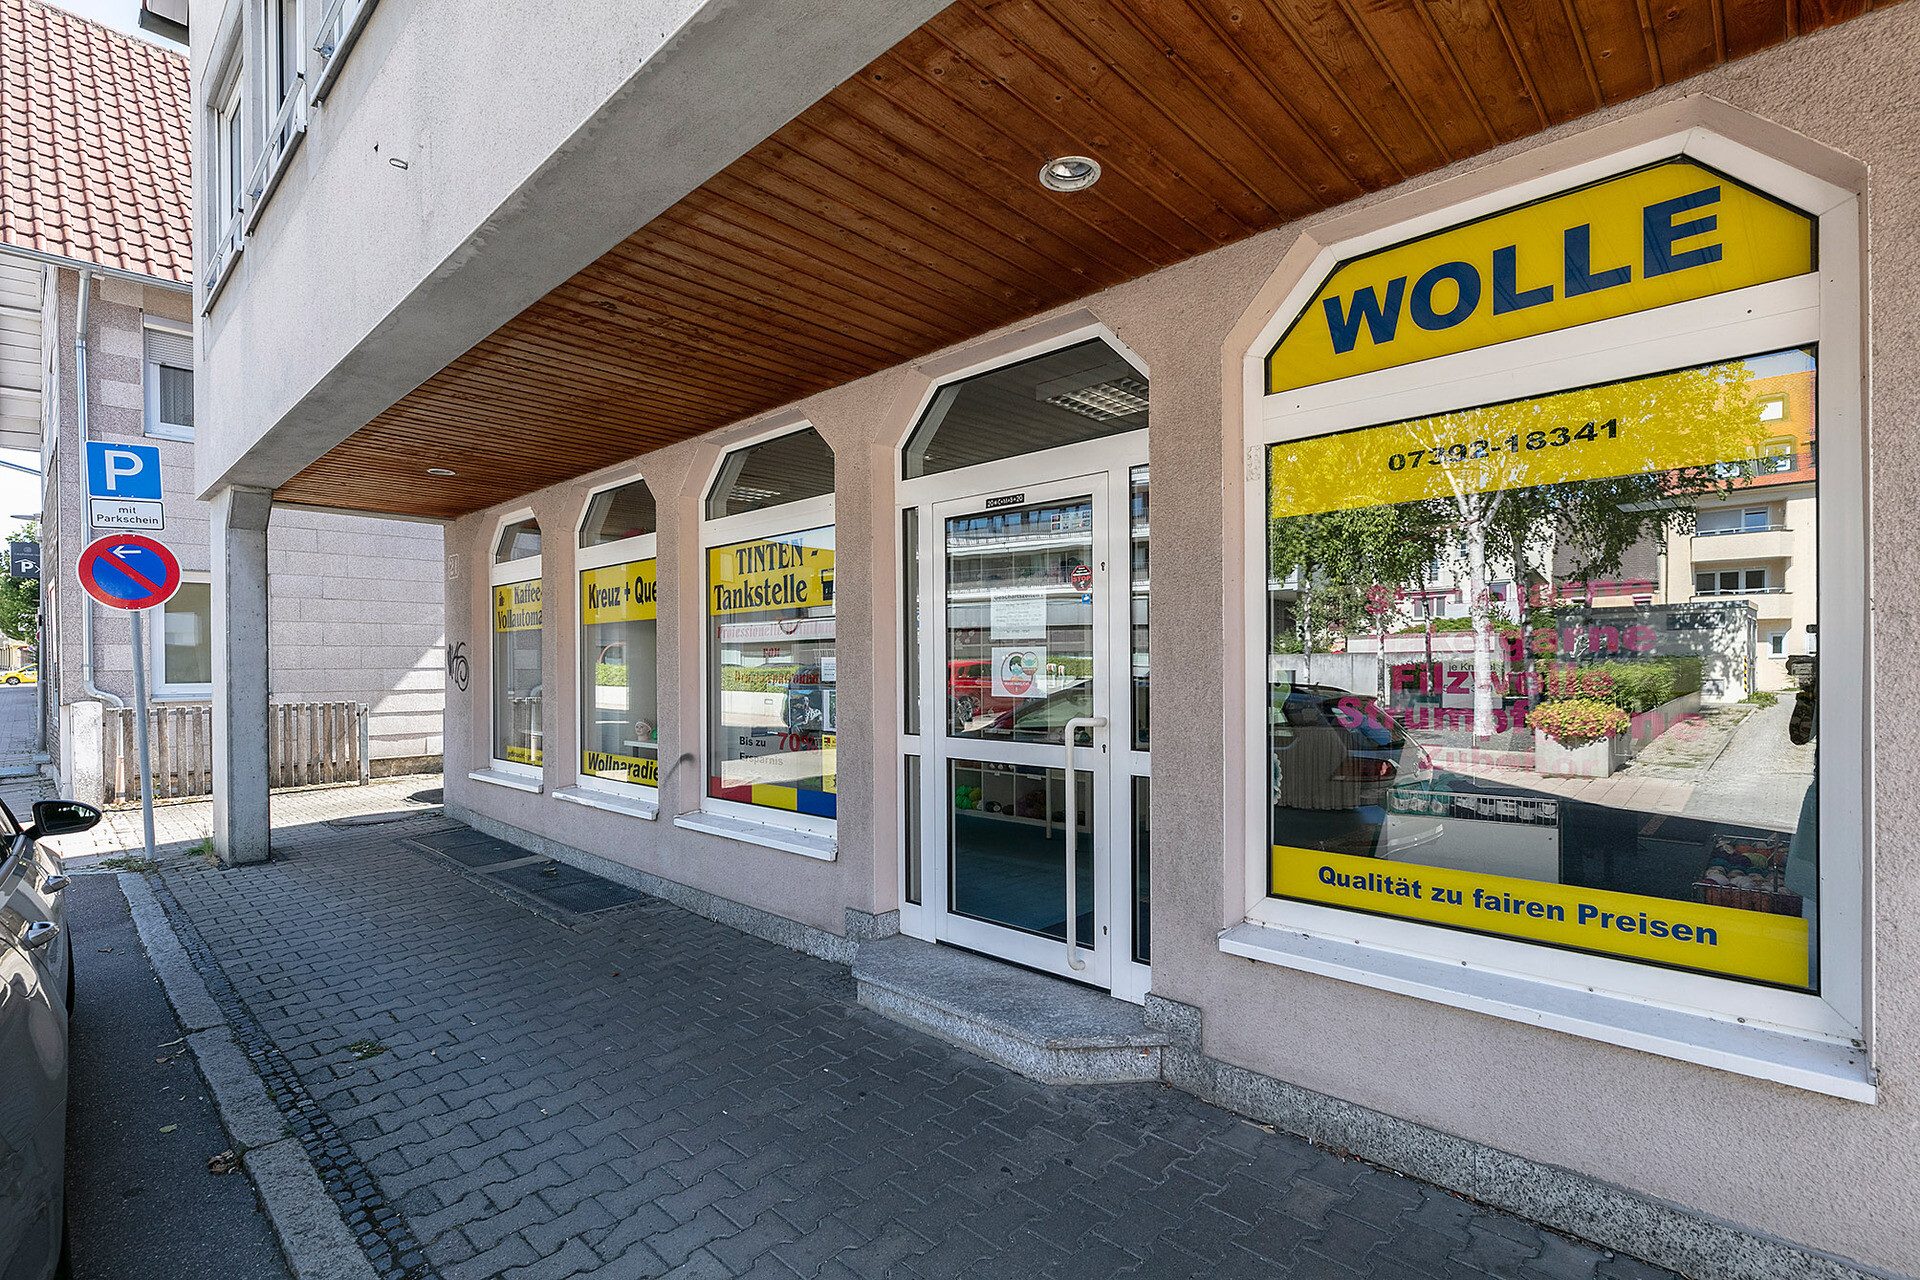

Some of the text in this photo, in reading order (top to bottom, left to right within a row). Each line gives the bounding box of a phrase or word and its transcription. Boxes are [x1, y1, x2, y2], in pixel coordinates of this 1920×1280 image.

[1322, 185, 1723, 354] WOLLE
[1388, 418, 1617, 472] 07392-18341
[104, 450, 143, 490] P
[97, 513, 159, 525] Parkschein
[118, 506, 137, 514] mit
[736, 539, 804, 576] TINTEN
[588, 576, 657, 610] Kreuz + Que
[714, 574, 808, 611] Tankstelle
[740, 736, 753, 747] Bis
[755, 739, 767, 748] zu
[776, 732, 818, 754] 70%
[740, 752, 784, 766] Ersparnis
[1317, 865, 1719, 946] Qualität zu fairen Preisen
